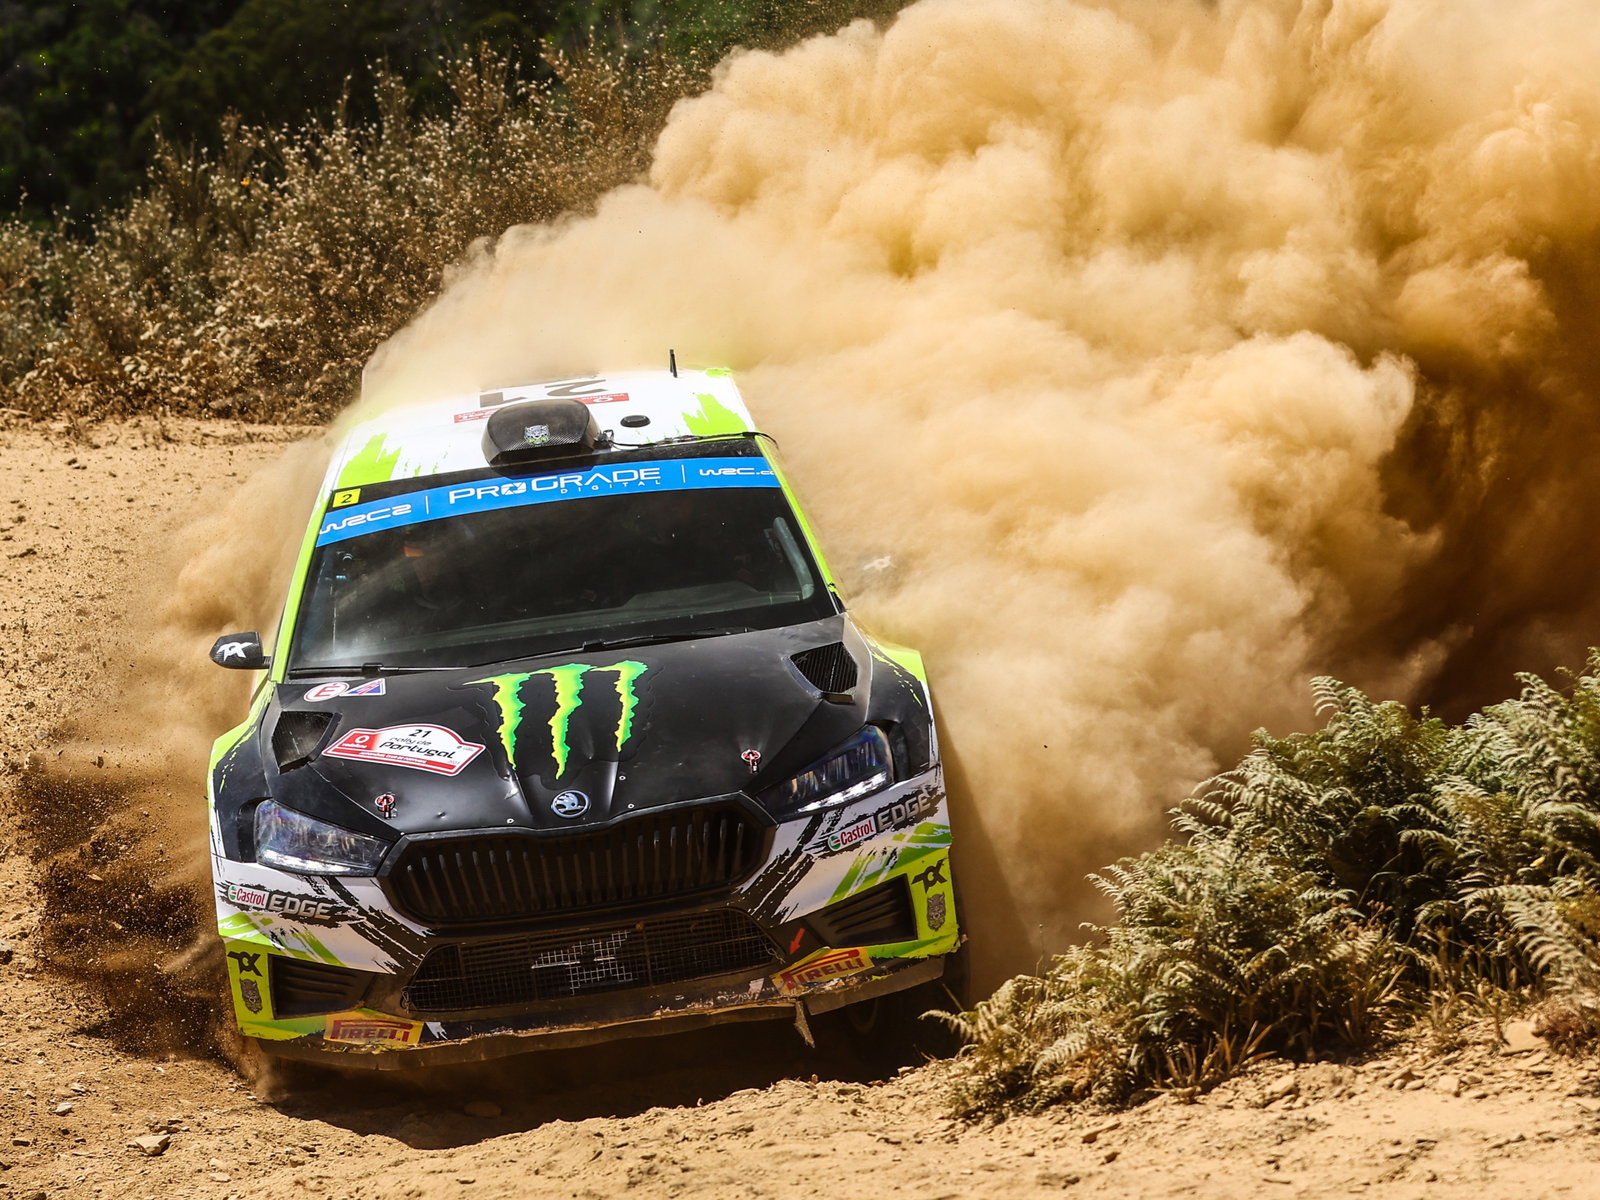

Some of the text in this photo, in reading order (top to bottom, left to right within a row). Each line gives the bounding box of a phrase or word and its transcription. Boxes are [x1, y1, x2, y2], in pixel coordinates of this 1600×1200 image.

[560, 479, 661, 494] DIGITAL
[341, 493, 353, 504] 2
[319, 504, 412, 535] WRC2
[389, 737, 416, 745] rally
[408, 729, 432, 738] 21
[379, 741, 456, 759] Portugal
[840, 793, 931, 846] Castrol EDGE
[236, 888, 333, 920] Castrol EDGE
[779, 949, 865, 989] PIRELLI
[330, 1019, 414, 1043] PIRELLI
